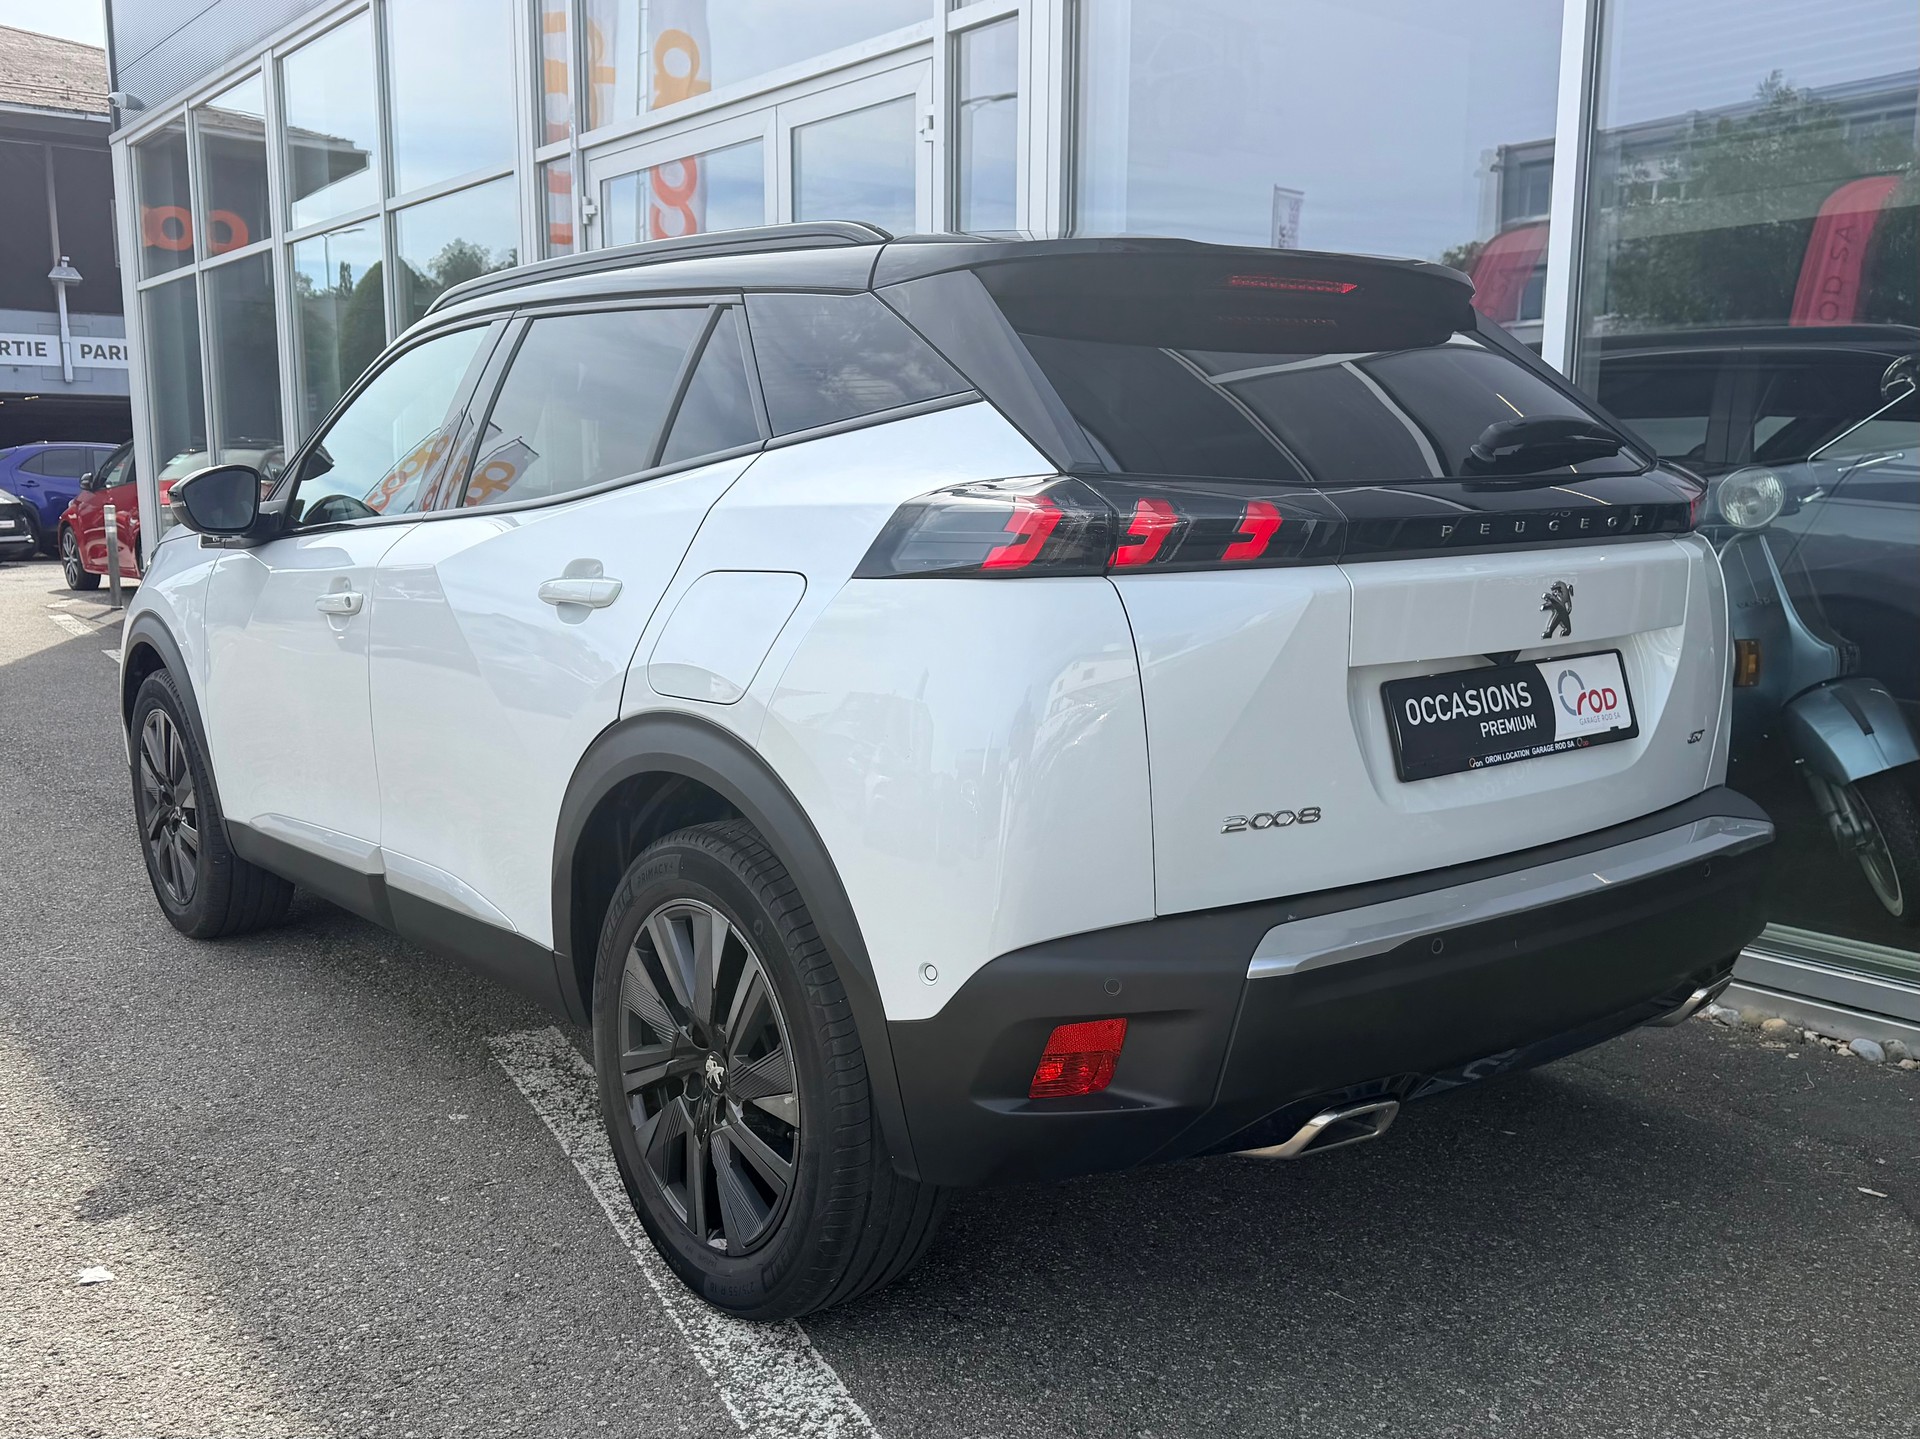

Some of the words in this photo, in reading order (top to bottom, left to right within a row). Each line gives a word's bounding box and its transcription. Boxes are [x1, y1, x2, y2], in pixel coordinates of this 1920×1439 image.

[80, 344, 128, 360] PAR
[1441, 514, 1643, 537] PEUGEOT
[1405, 681, 1532, 726] OCCASIONS
[1480, 714, 1537, 738] PREMIUM
[1579, 716, 1601, 726] GARAGE
[1600, 713, 1613, 723] ROD
[1614, 712, 1621, 721] SA
[1485, 754, 1501, 764] ORON
[1503, 749, 1530, 761] LOCATION
[1532, 745, 1554, 756] GARAGE
[1555, 742, 1566, 751] ROD
[1221, 806, 1321, 834] 2008
